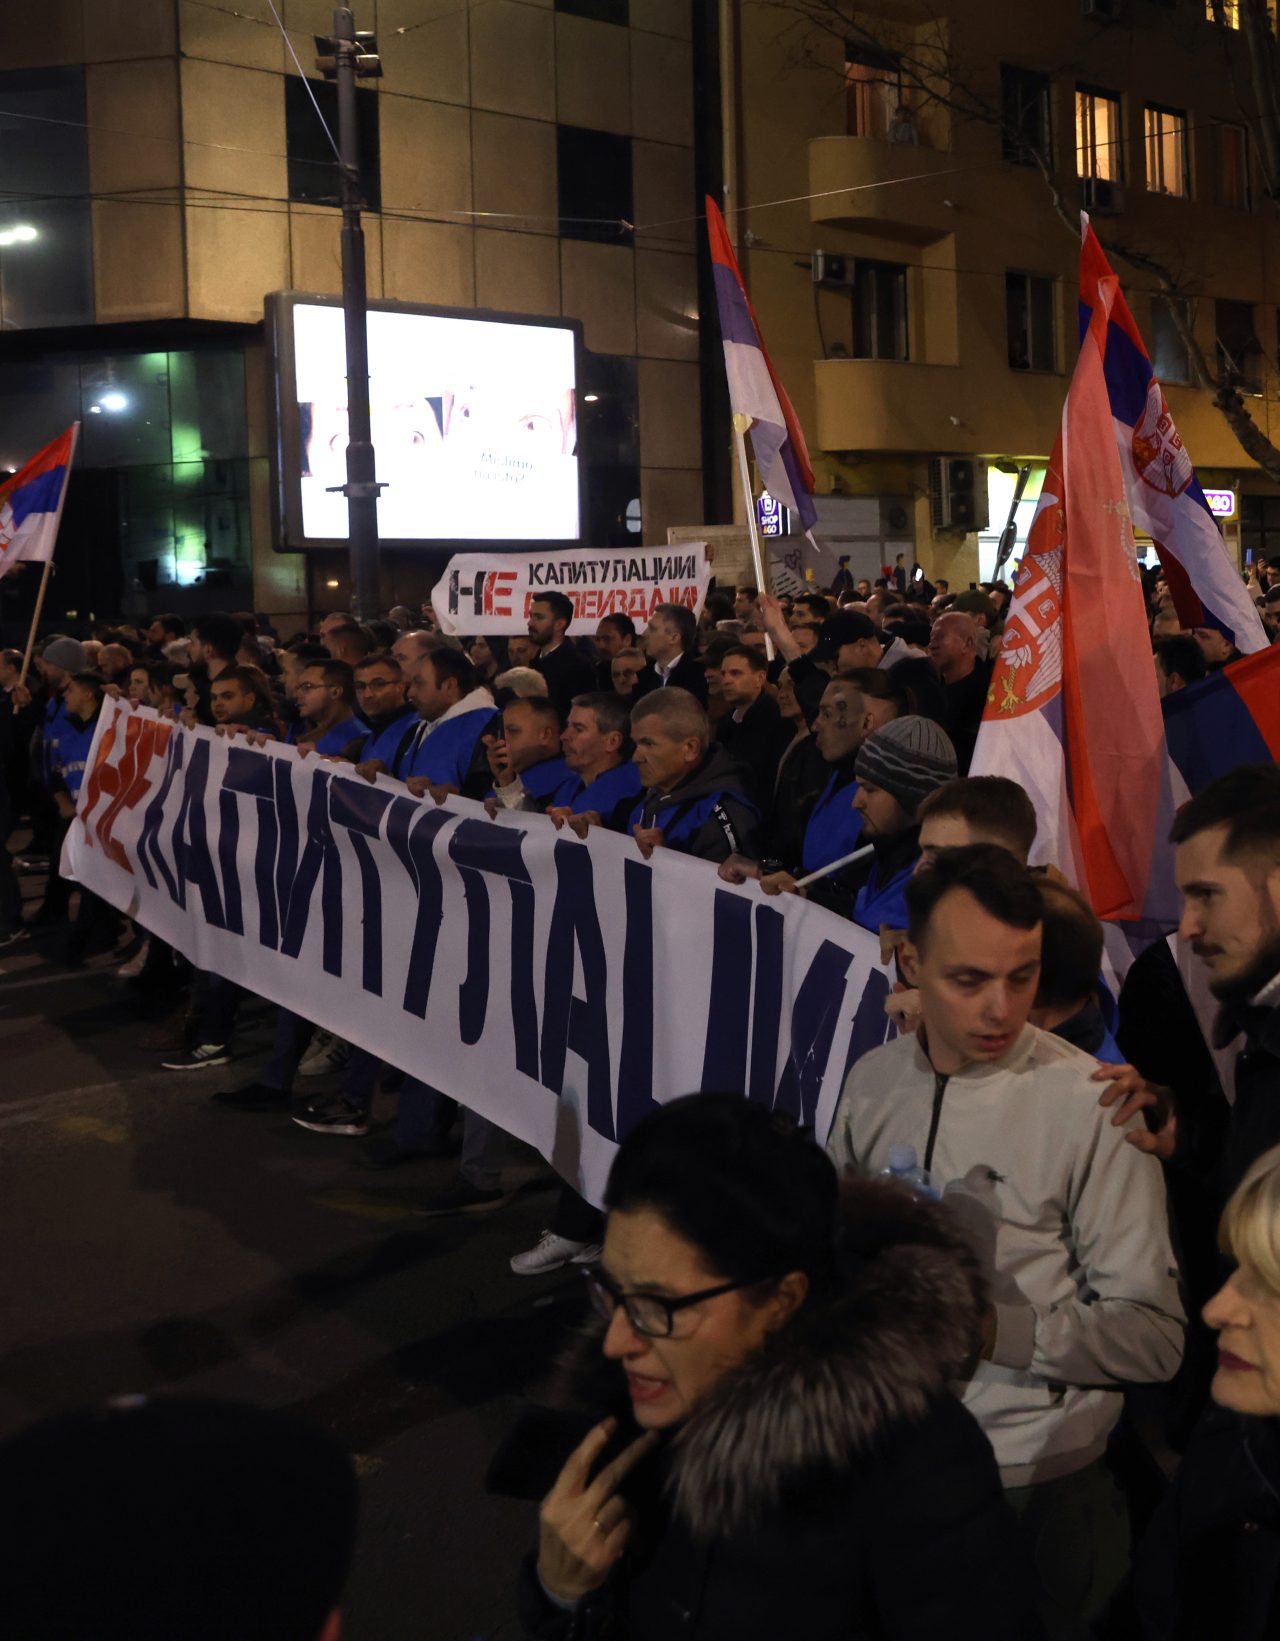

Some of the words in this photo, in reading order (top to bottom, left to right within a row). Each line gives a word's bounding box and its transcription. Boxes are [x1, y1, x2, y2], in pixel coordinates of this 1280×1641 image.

[761, 514, 778, 525] SHOP
[528, 555, 696, 586] КАПИТУЛАЦИЈИ!
[449, 569, 518, 616] НЕ
